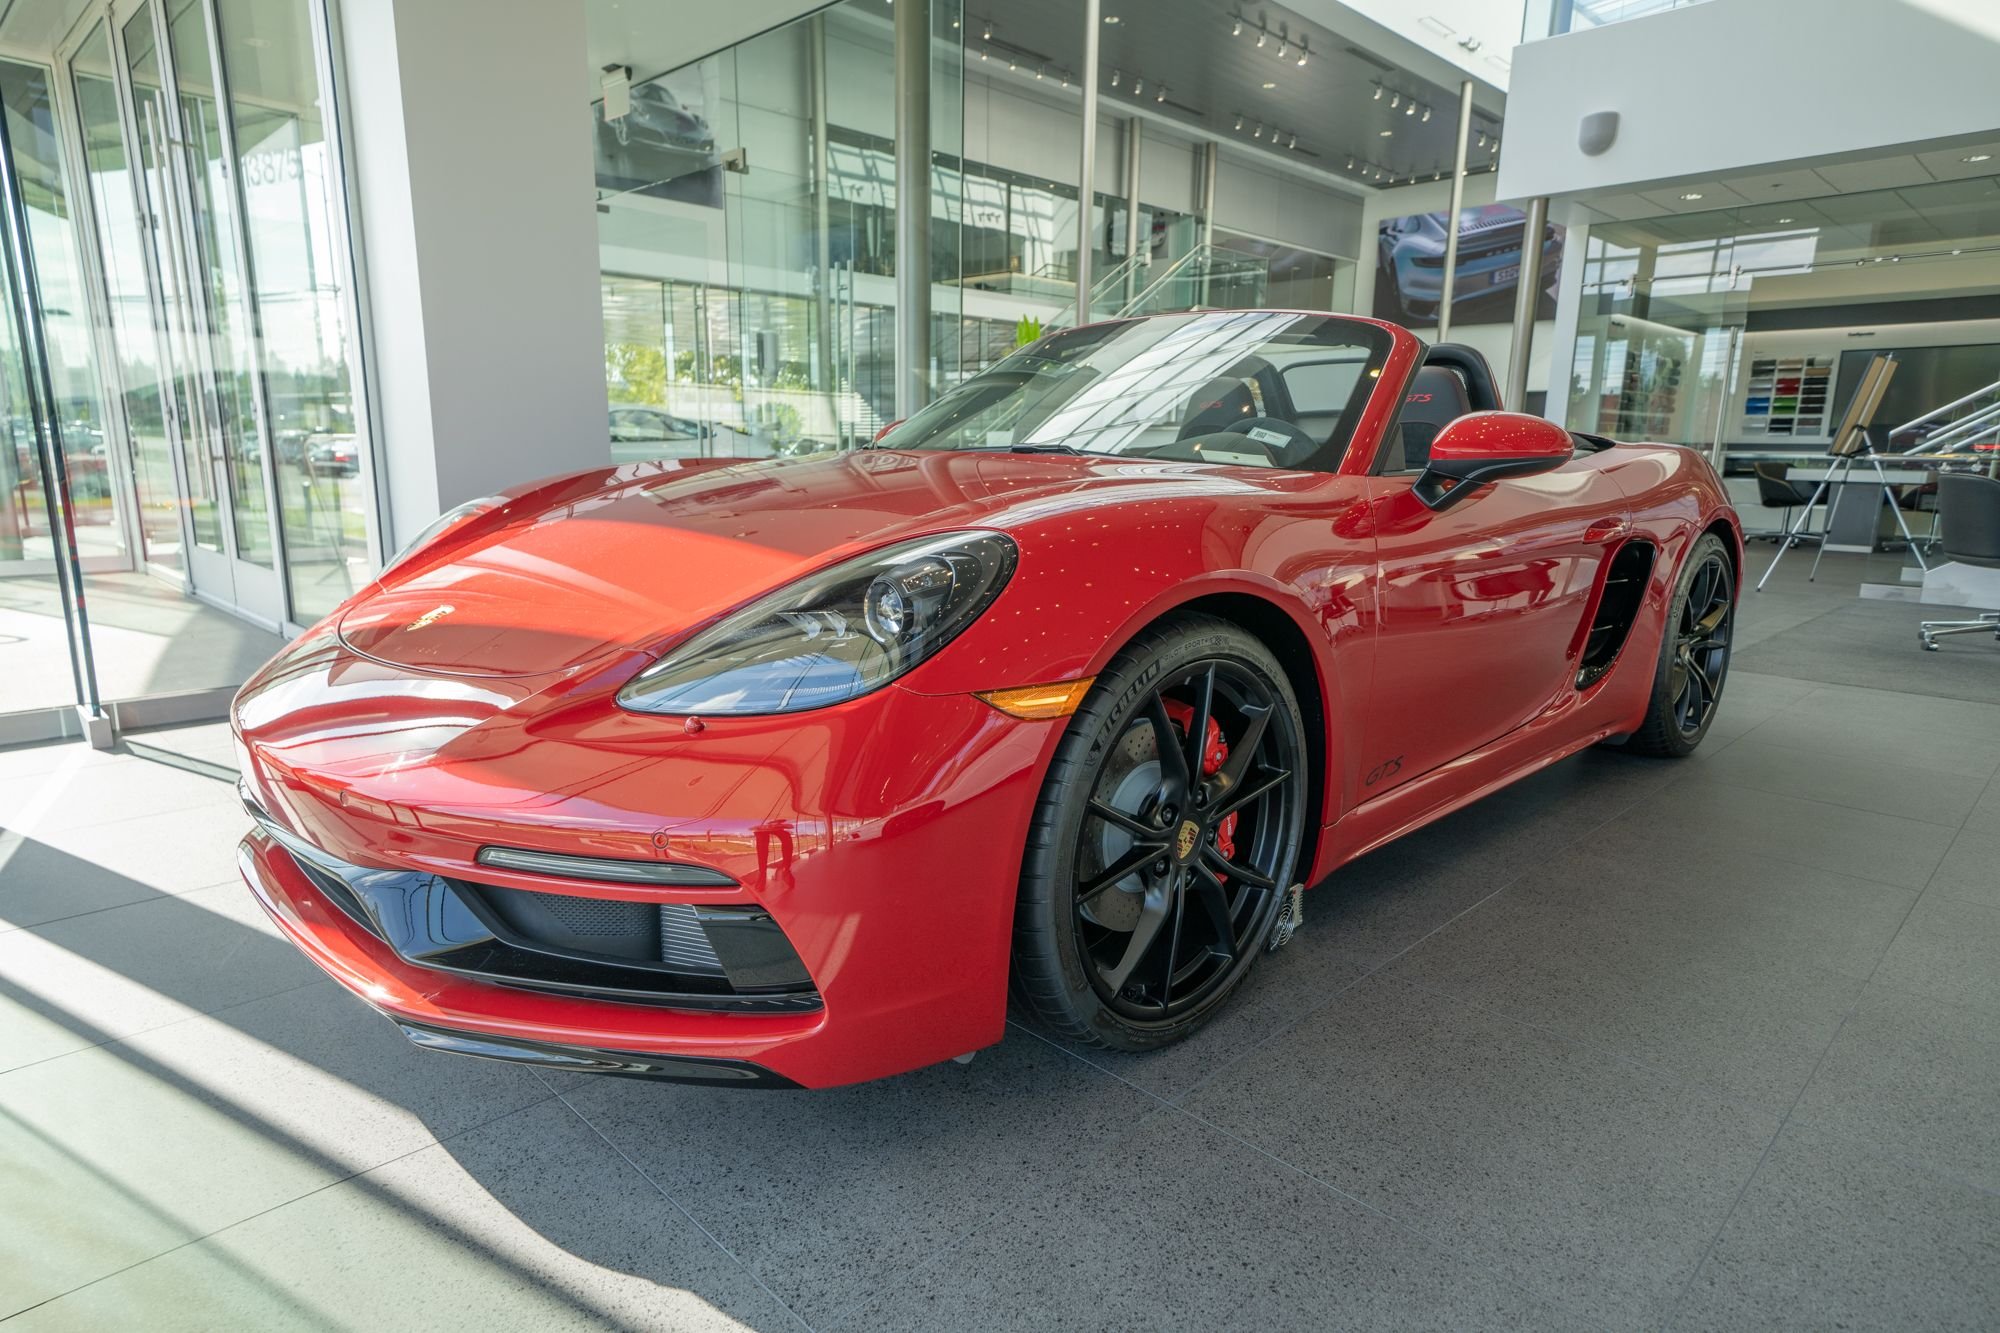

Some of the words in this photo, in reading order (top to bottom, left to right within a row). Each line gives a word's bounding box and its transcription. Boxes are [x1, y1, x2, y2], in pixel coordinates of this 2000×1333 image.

[1184, 638, 1206, 651] SPORT
[1096, 661, 1160, 747] MICHELIN
[1365, 755, 1404, 787] GTS
